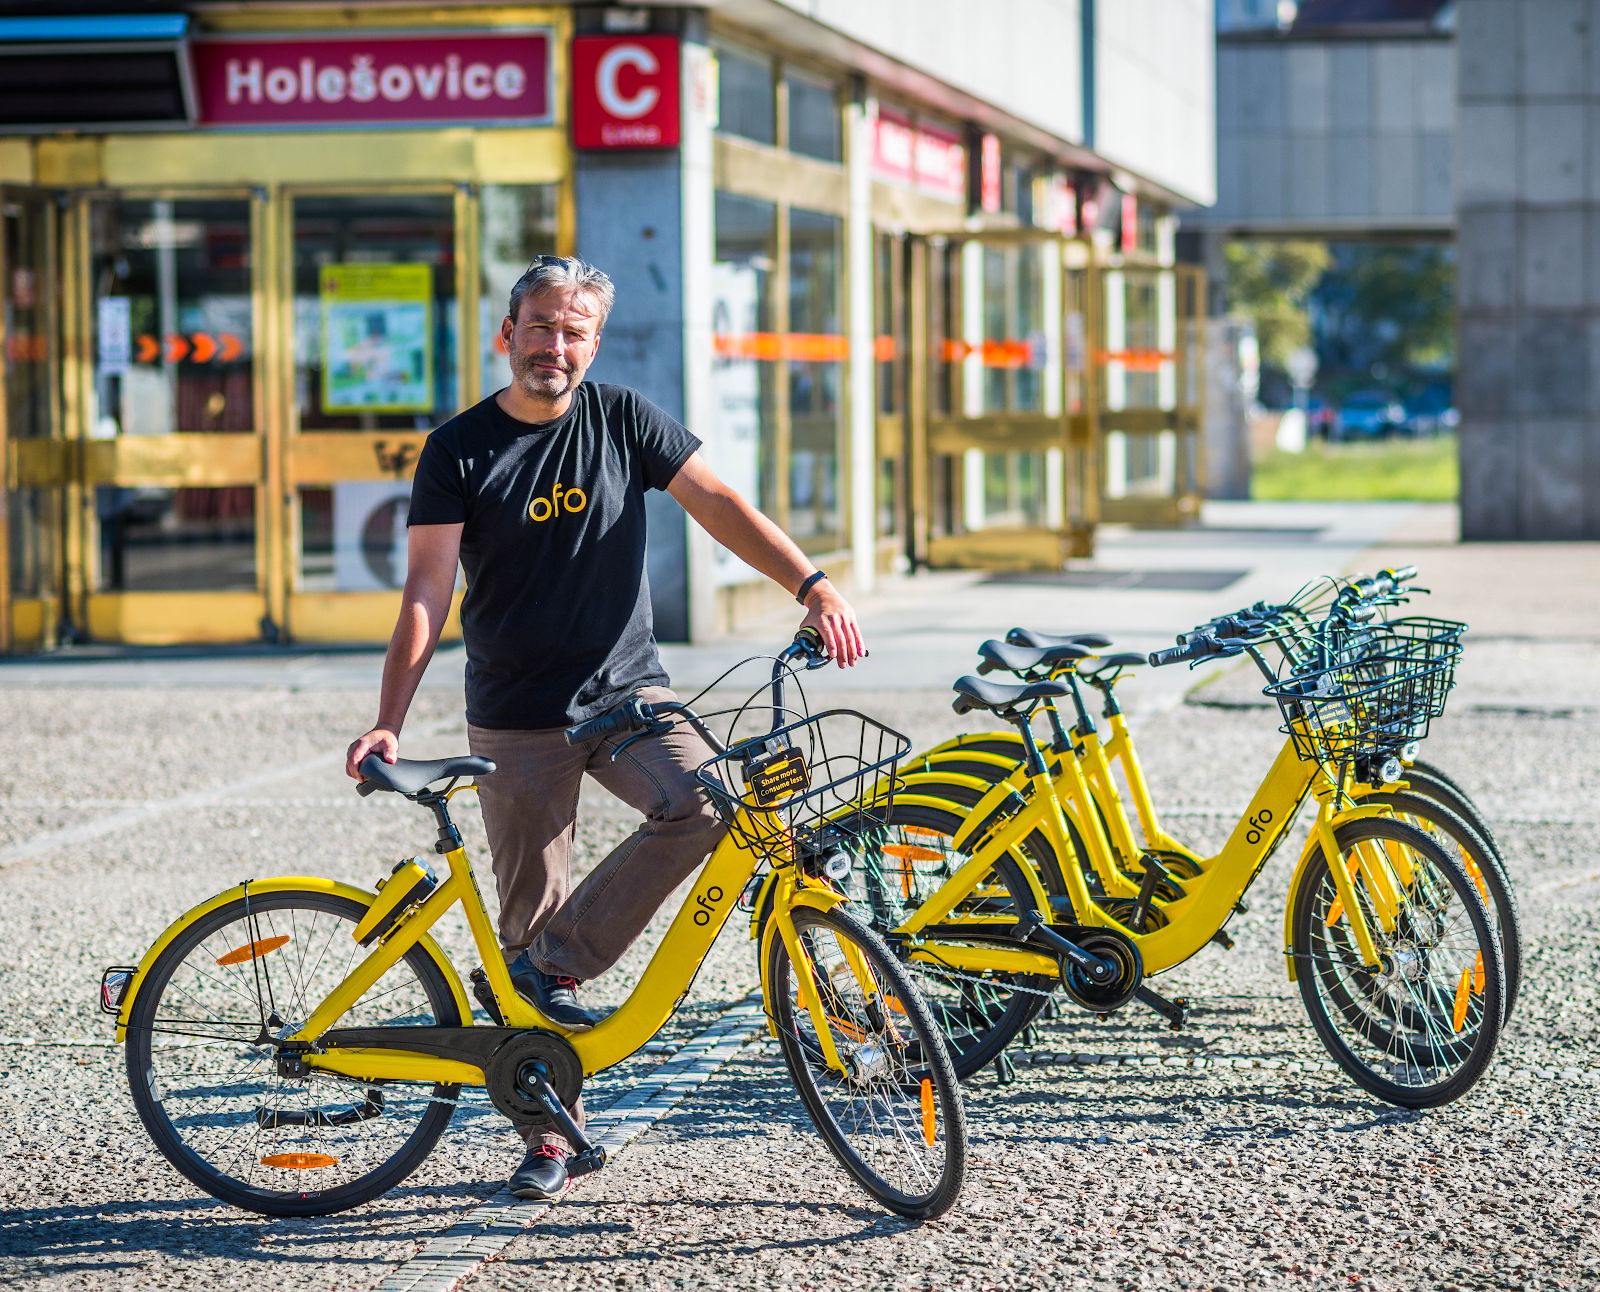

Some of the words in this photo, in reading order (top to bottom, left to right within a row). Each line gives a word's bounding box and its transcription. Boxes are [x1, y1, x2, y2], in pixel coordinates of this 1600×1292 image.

[225, 54, 526, 104] Holešovice
[595, 43, 660, 119] C
[528, 483, 587, 521] ofo
[760, 780, 790, 797] Consume
[790, 775, 803, 787] less
[761, 775, 780, 787] Share
[780, 768, 797, 779] more
[1246, 809, 1272, 845] ofo
[693, 886, 723, 926] ofo
